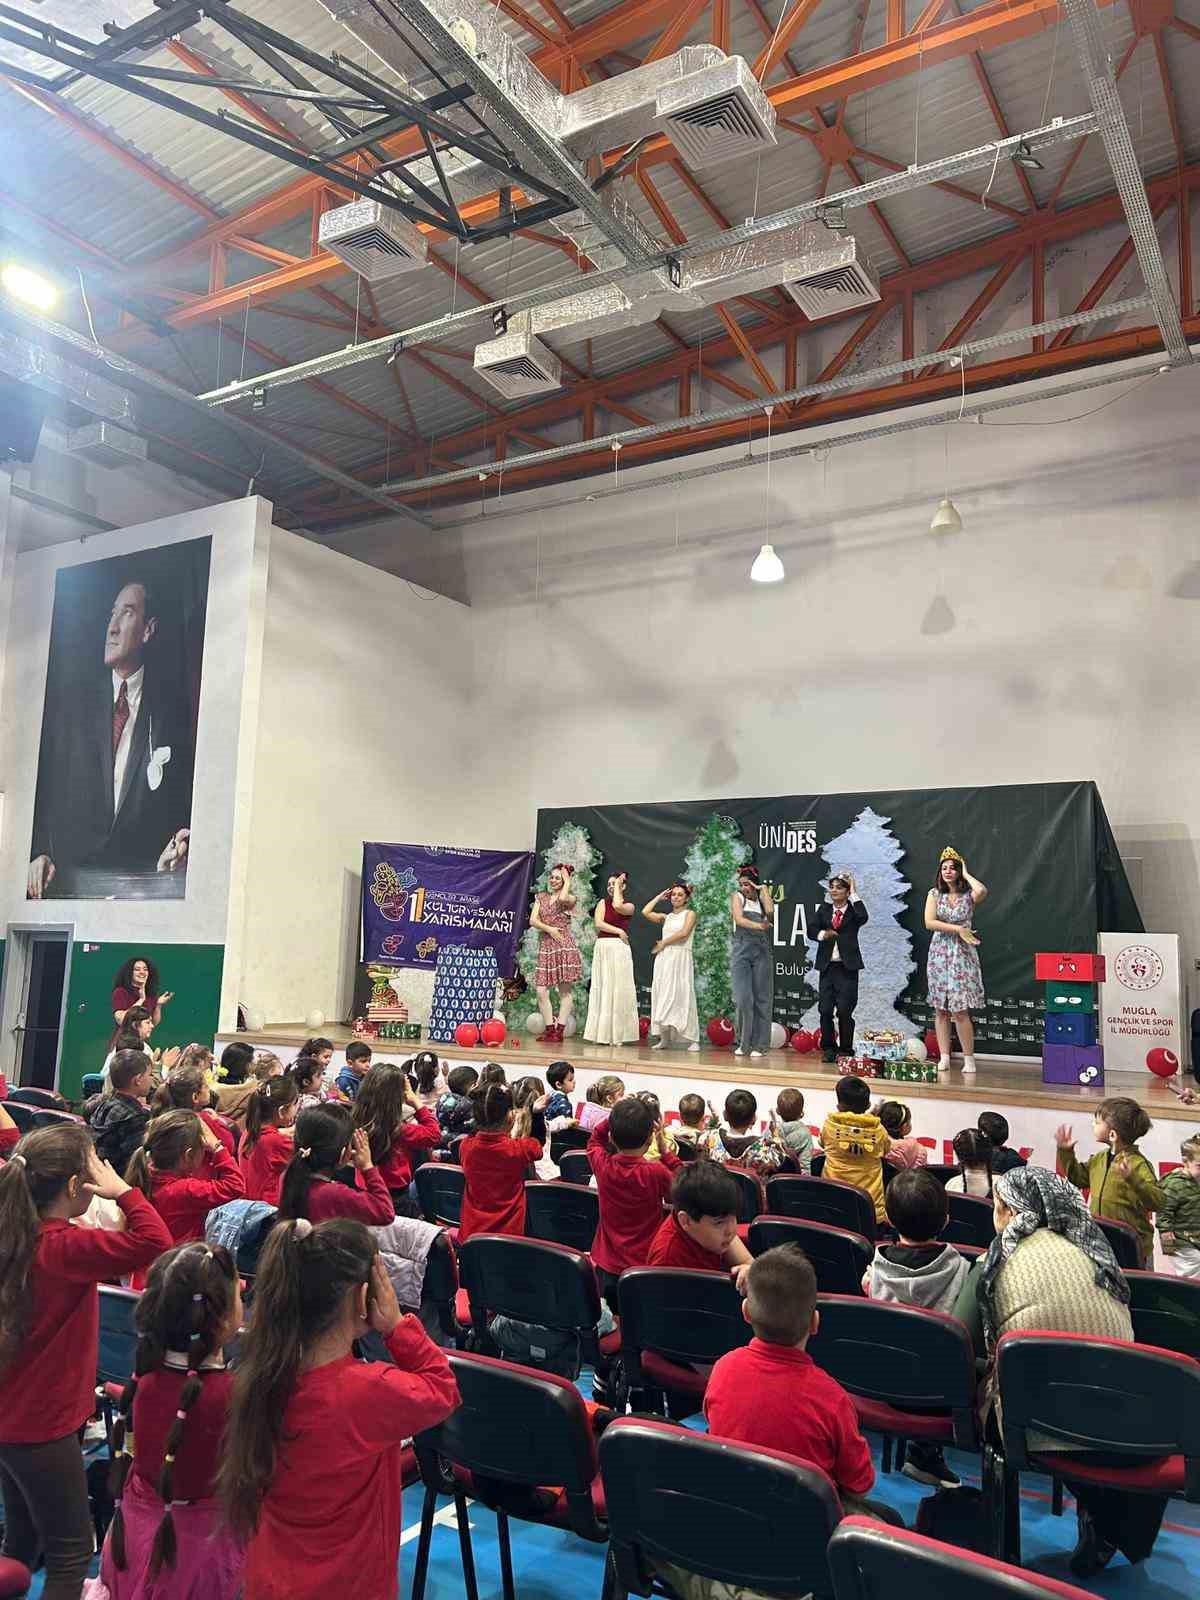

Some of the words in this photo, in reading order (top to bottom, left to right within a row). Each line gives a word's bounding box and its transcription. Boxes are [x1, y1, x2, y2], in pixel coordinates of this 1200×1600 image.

[478, 907, 515, 920] SANAT
[1141, 1018, 1152, 1026] VE
[1152, 1018, 1174, 1027] SPOR
